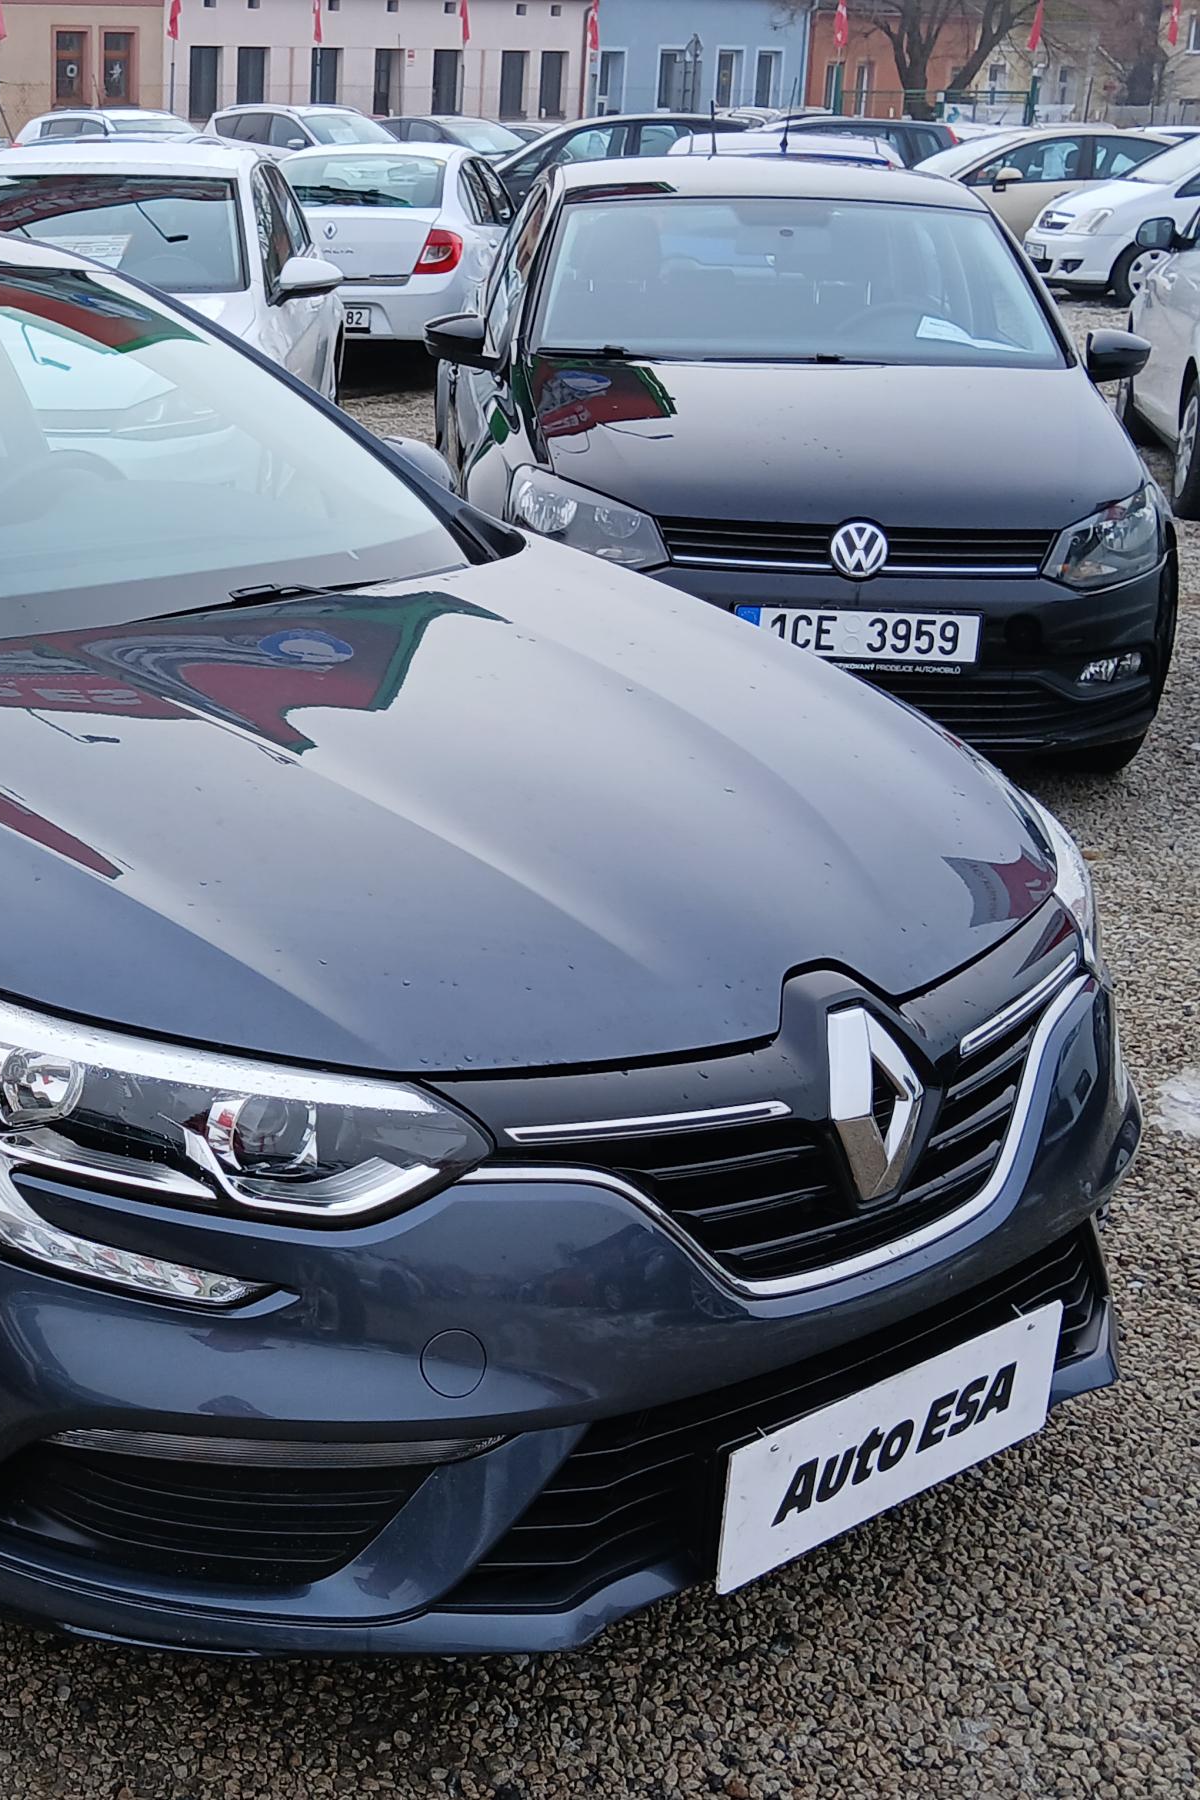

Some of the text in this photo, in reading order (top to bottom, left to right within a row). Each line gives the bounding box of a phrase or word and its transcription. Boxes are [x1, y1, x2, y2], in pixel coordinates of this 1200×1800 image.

[346, 311, 363, 326] 82
[770, 613, 960, 656] 1CE 3959
[771, 1361, 1018, 1528] Auto ESA
